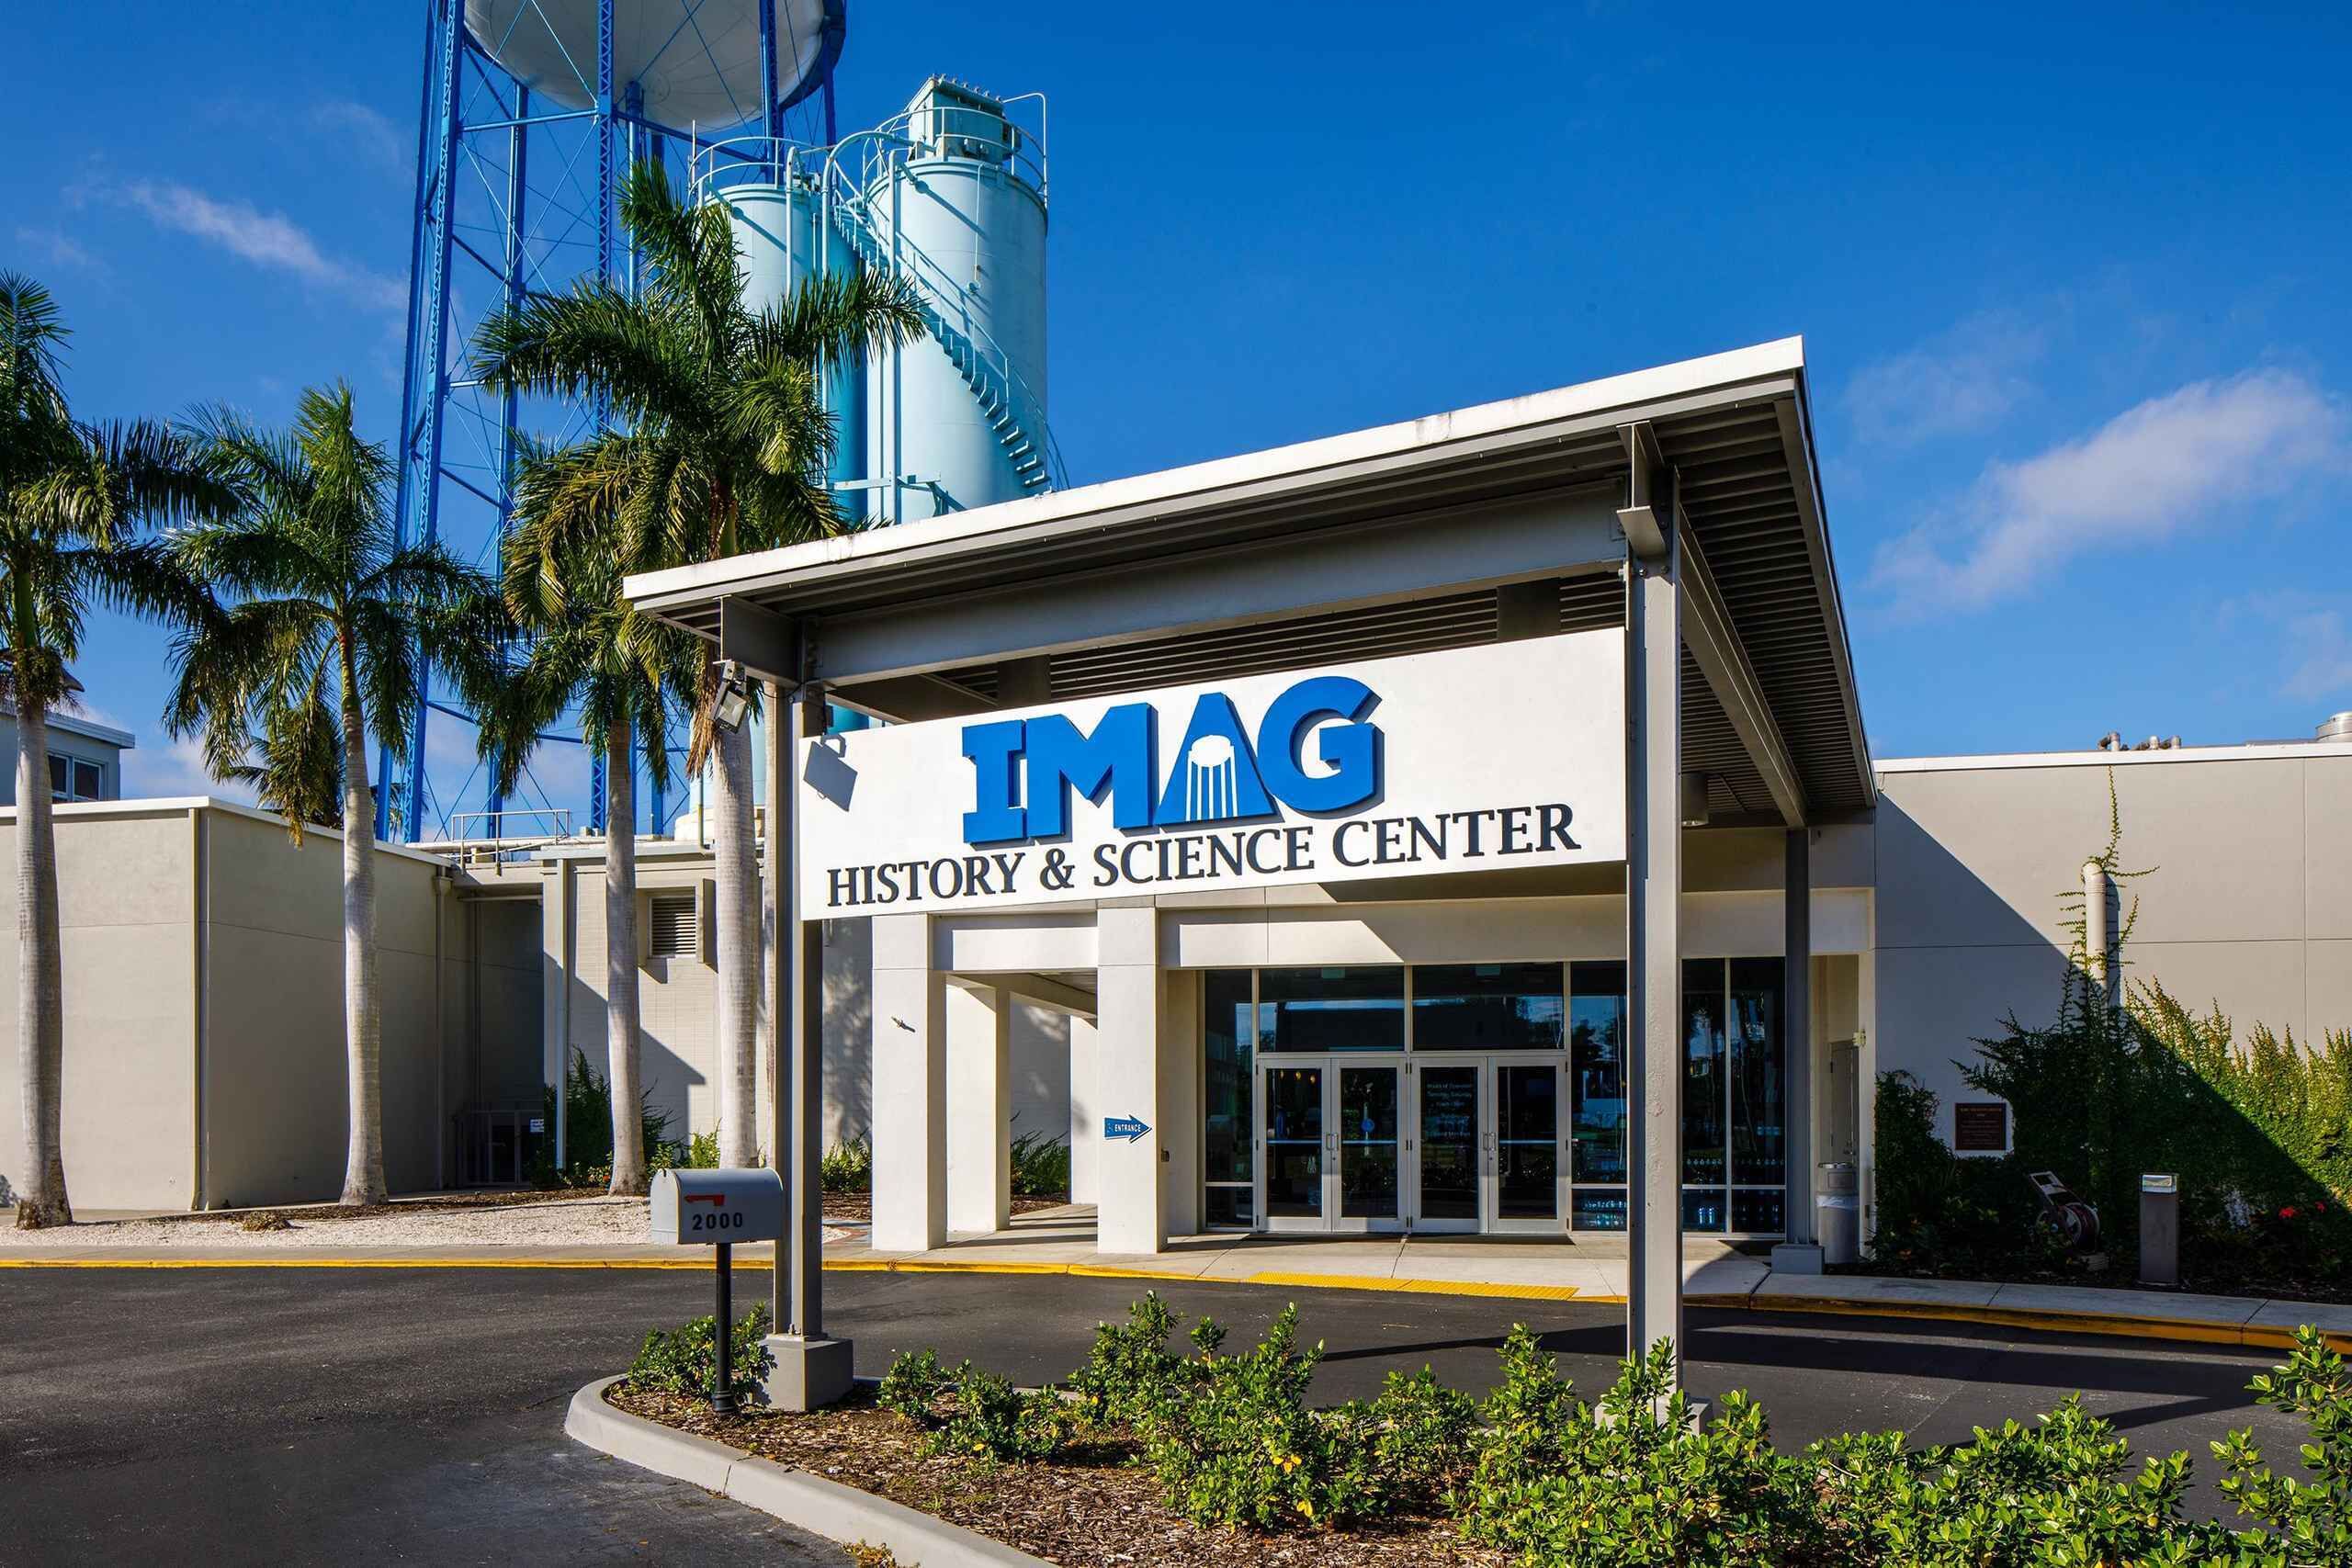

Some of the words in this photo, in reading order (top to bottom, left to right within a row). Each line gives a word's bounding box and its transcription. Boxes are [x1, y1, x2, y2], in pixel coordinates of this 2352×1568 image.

[962, 676, 1382, 843] IMAG
[827, 852, 1026, 907] HISTORY
[1039, 848, 1075, 890] &
[1093, 826, 1315, 886] SCIENCE
[1332, 803, 1581, 866] CENTER
[1114, 1123, 1141, 1133] ENTRANCE
[692, 1213, 743, 1231] 2000
